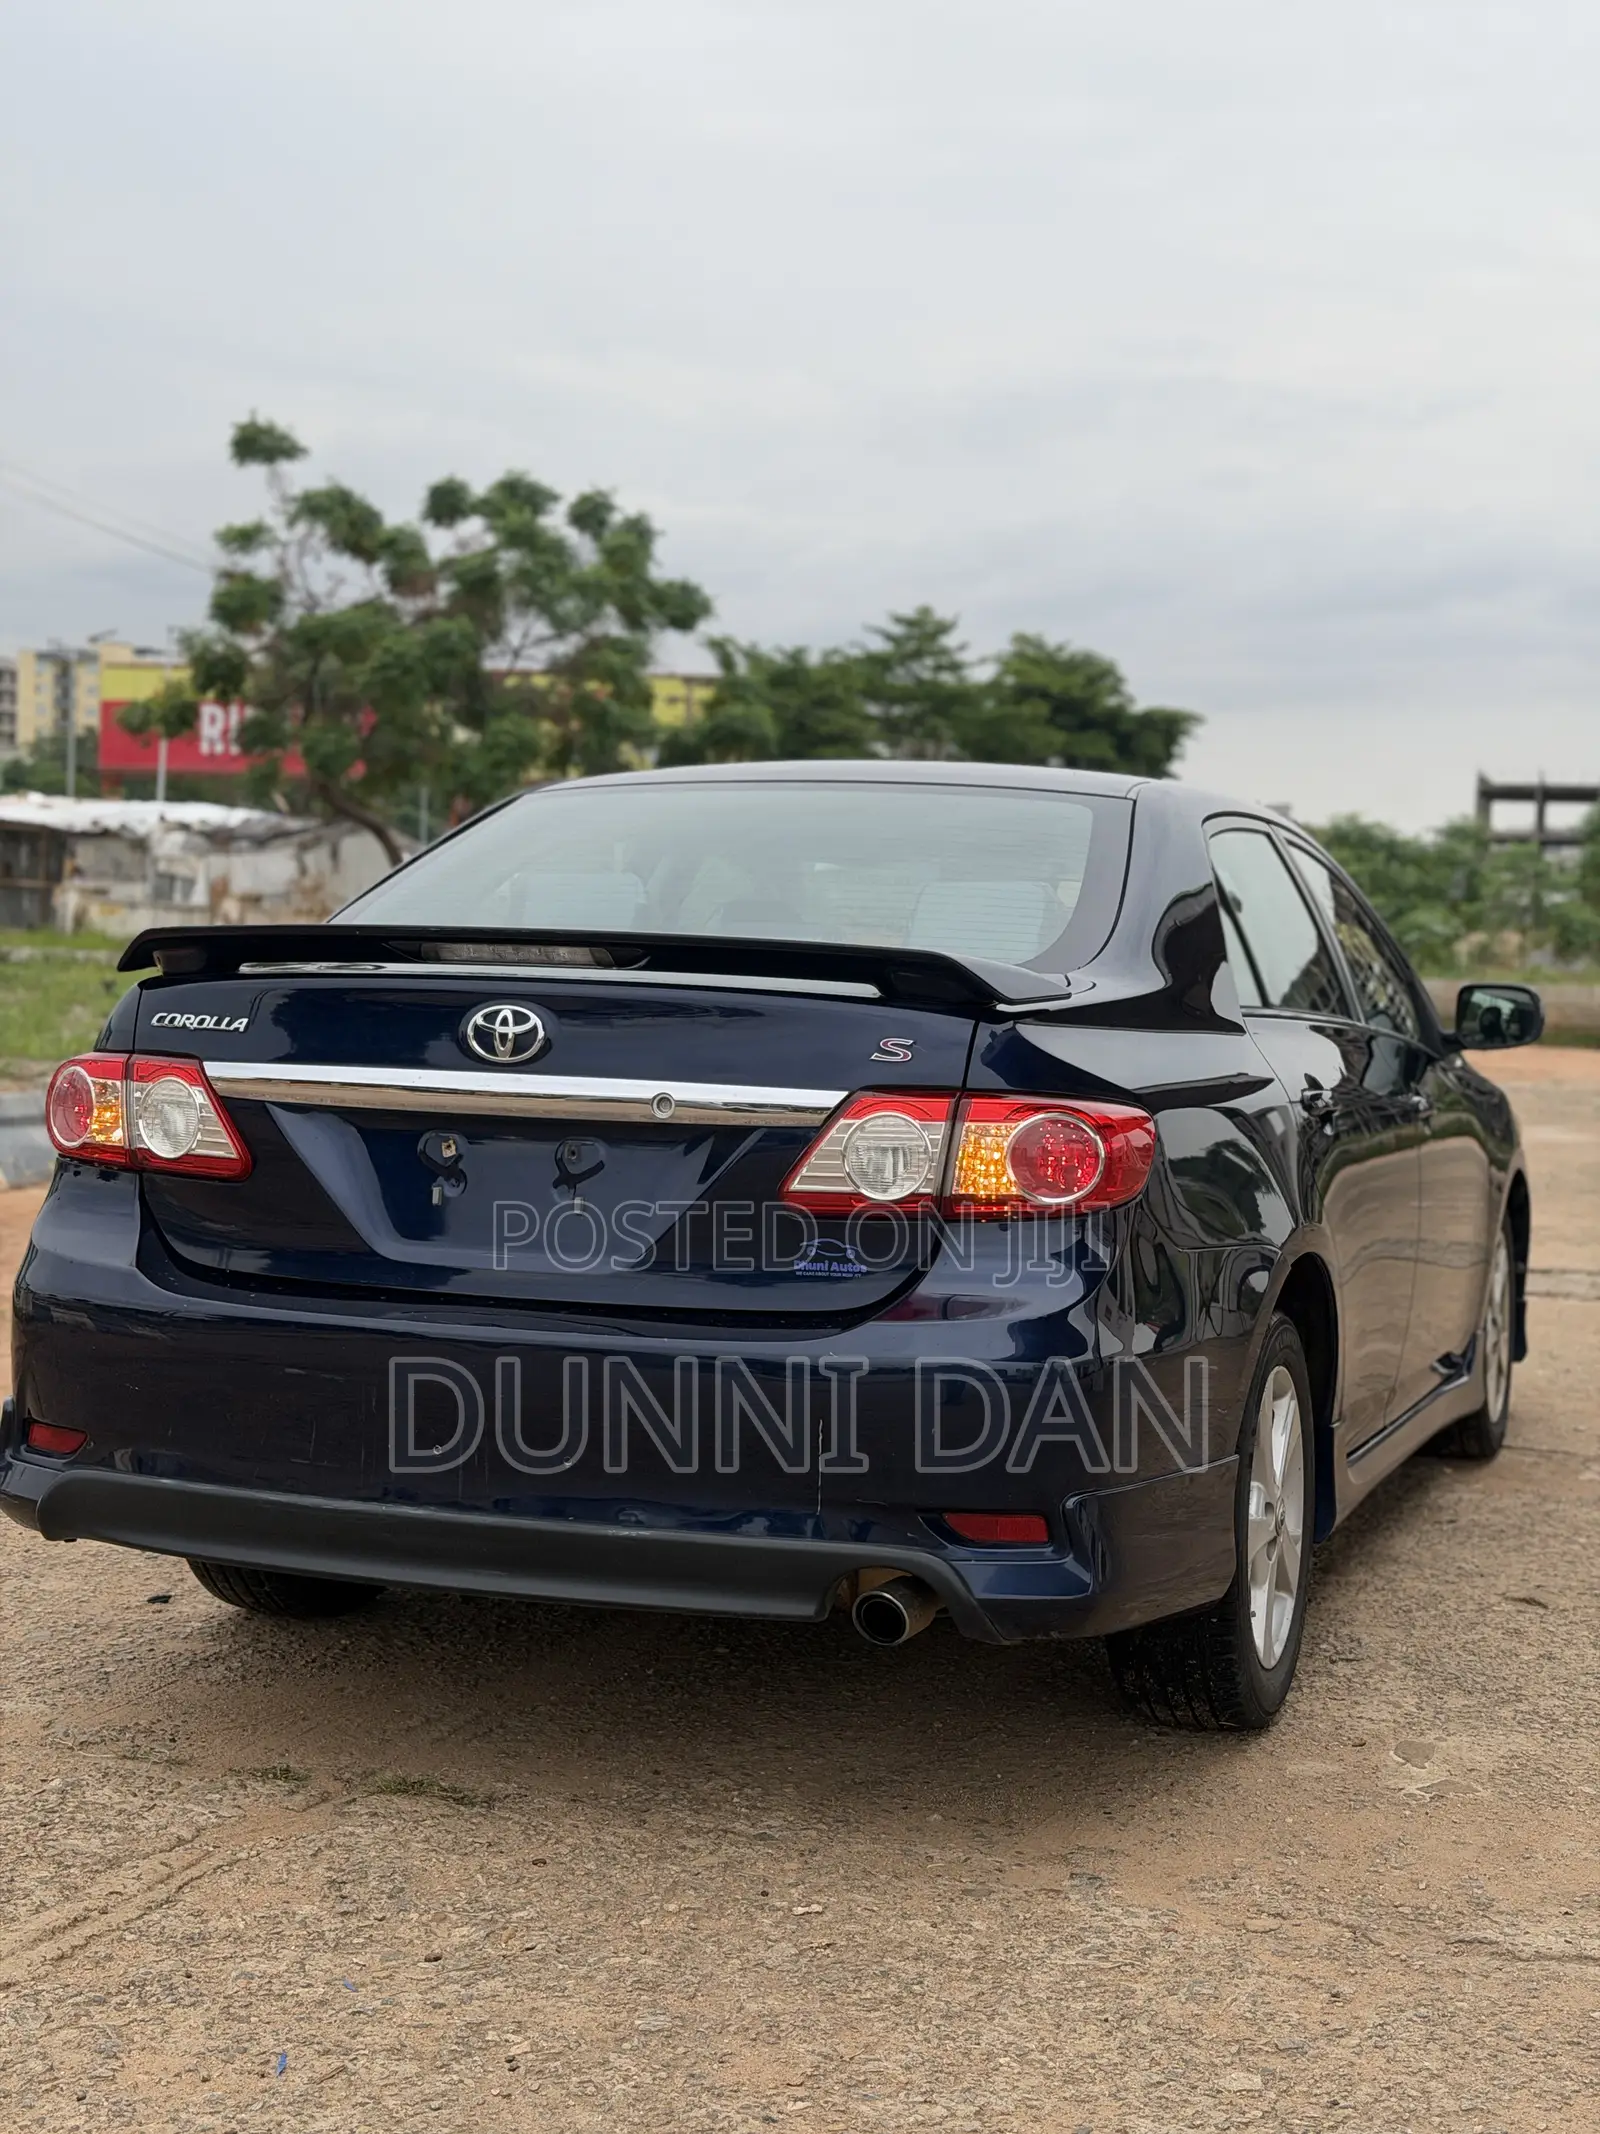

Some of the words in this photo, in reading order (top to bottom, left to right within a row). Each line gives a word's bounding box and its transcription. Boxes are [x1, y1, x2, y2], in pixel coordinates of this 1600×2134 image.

[150, 1012, 249, 1033] COROLLA
[869, 1037, 914, 1062] S
[830, 1261, 867, 1273] Autos
